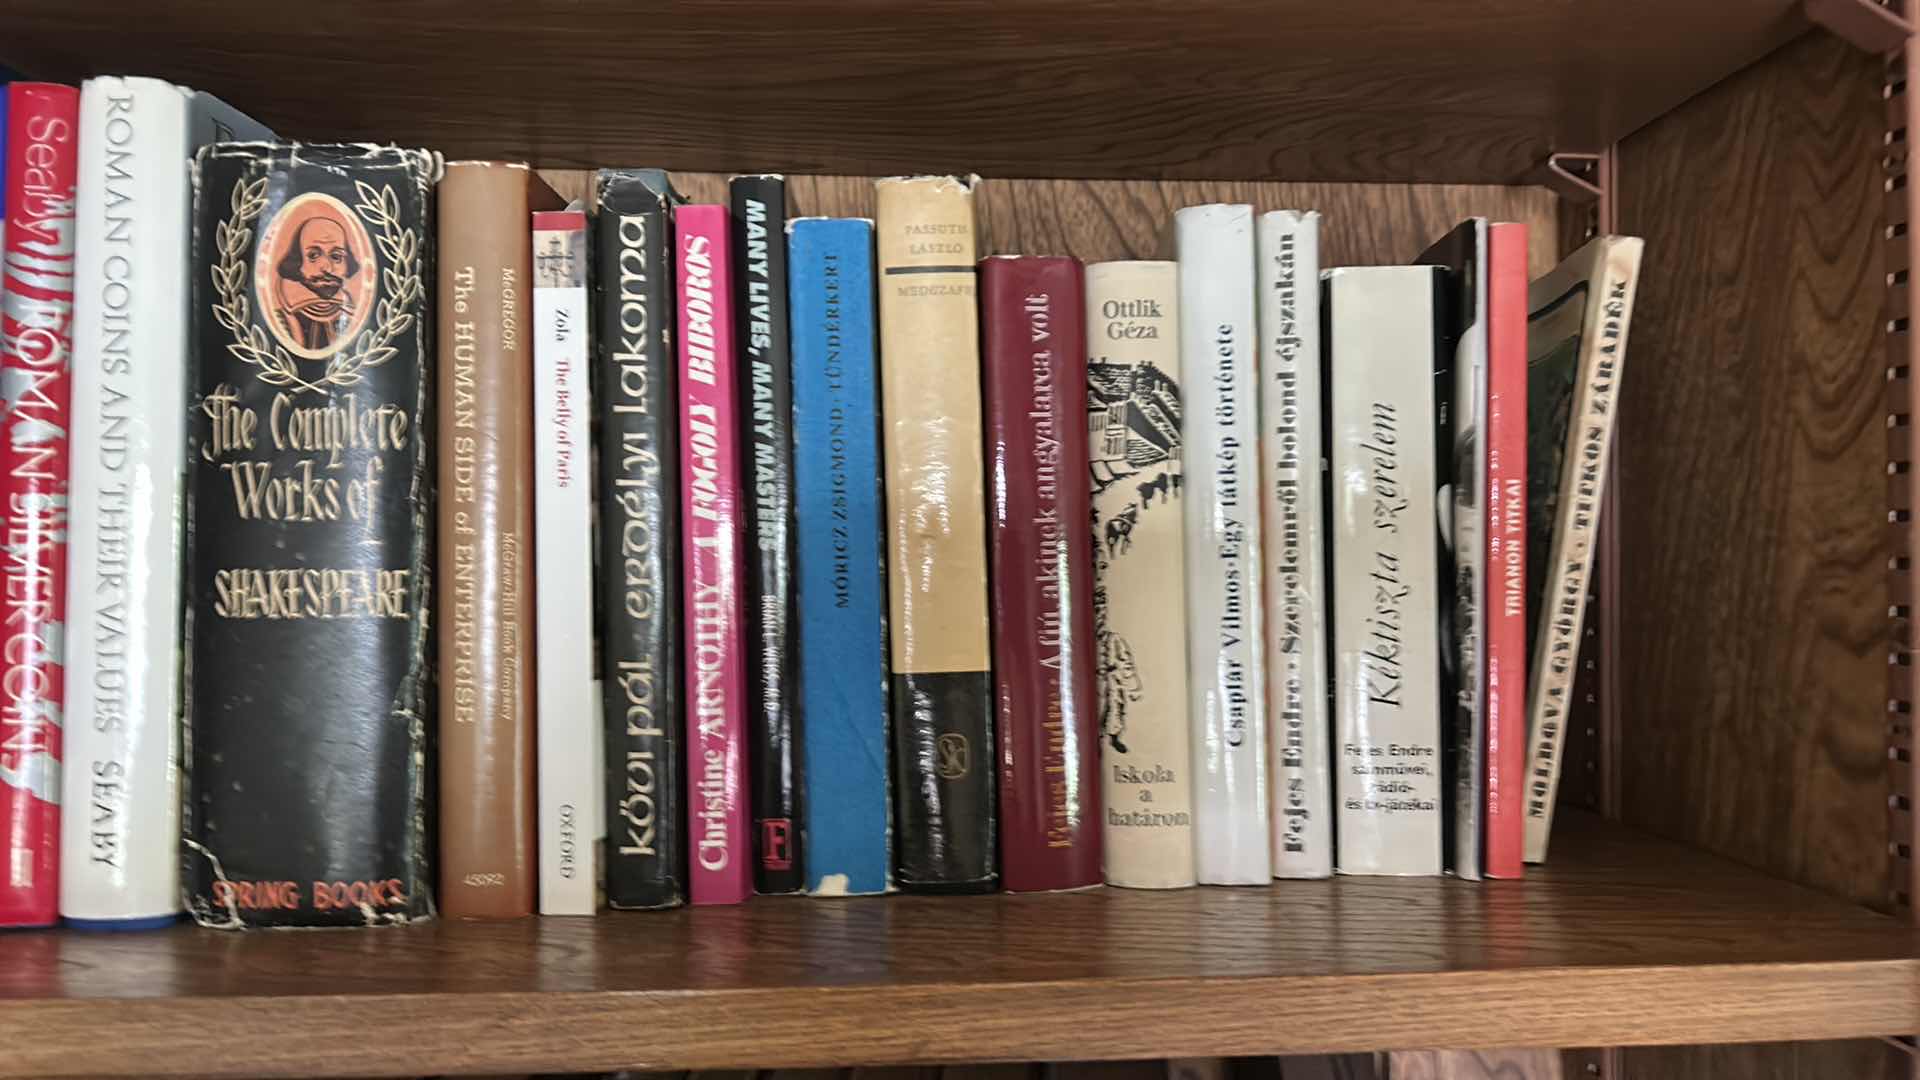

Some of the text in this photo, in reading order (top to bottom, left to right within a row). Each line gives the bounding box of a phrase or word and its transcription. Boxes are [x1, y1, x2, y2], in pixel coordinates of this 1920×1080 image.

[13, 115, 70, 241] Seaby
[502, 267, 518, 351] McGREGOR
[1023, 293, 1052, 342] volt
[1103, 300, 1163, 319] Ottlik
[1107, 321, 1159, 340] Géza
[1273, 233, 1303, 363] éjszakán
[10, 304, 66, 480] ROMAN
[93, 93, 135, 734] ROMAN COINS AND THEIR VALUES
[554, 308, 573, 488] Zola The Belly of Paris
[746, 199, 780, 551] MANY LIVES, MANY MASTERS
[1213, 323, 1236, 427] története
[201, 382, 408, 469] The Complete
[688, 395, 719, 521] FOGOLY
[829, 406, 849, 522] ZSIGMOND
[1027, 350, 1064, 500] angyalarca
[1276, 371, 1298, 469] bolond
[220, 455, 385, 531] Works of
[454, 266, 476, 723] The HUMAN SIDE of ENTERPRISE
[1360, 402, 1410, 534] szerelem
[5, 491, 56, 625] SILVER
[831, 526, 850, 609] MÓRICZ
[1032, 507, 1061, 600] akinek
[1504, 478, 1522, 617] TRIANON TITKAI
[1529, 280, 1627, 818] MOLDOVA GYÖRGY TITKOS ZÁRADÉK
[214, 568, 411, 619] SHAKESPEARE
[501, 620, 518, 653] Book
[761, 594, 780, 630] BRIAN
[500, 657, 518, 720] Company
[1224, 658, 1247, 747] Csaplár
[1281, 679, 1304, 768] Endre
[1113, 765, 1176, 784] Iskola
[1344, 743, 1433, 757] Fees Endre
[90, 760, 125, 870] SEABY
[697, 749, 729, 871] Christine
[1108, 807, 1190, 827] határon
[1139, 789, 1153, 802] a
[1283, 778, 1311, 853] Fejes
[559, 804, 576, 879] OXFORD
[212, 879, 407, 911] SPRING BOOKS
